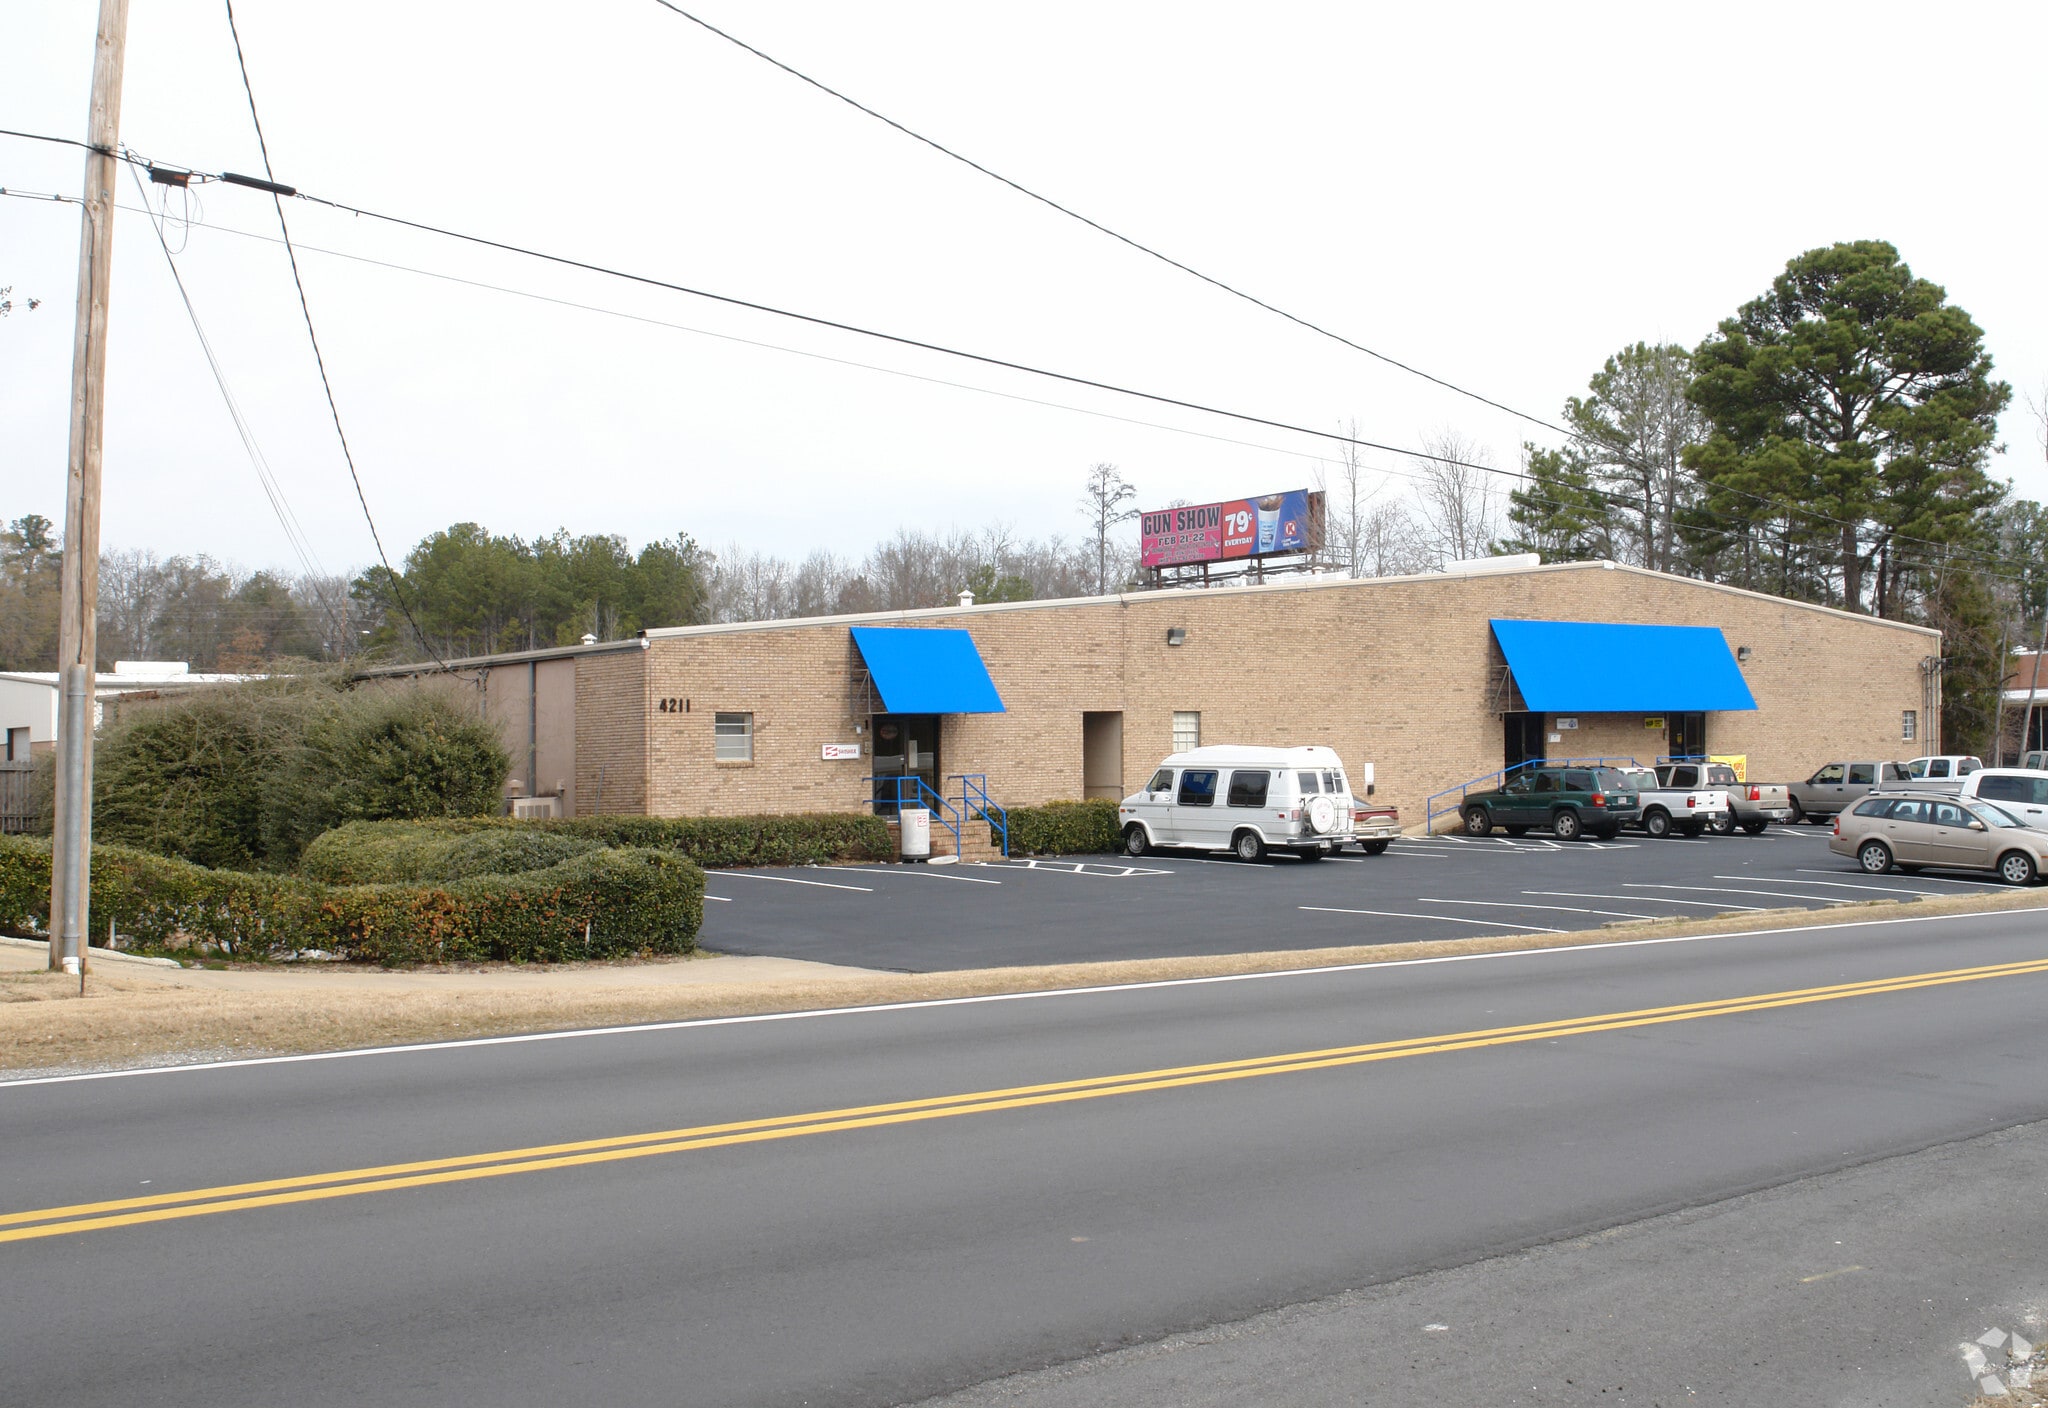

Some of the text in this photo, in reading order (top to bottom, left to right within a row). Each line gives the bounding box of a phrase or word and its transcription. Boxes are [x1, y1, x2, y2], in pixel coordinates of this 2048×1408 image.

[1144, 506, 1220, 536] GUN SHOW
[1158, 532, 1205, 546] FEB 21-22
[1224, 537, 1253, 547] EVERYDAY
[659, 697, 691, 713] 4211
